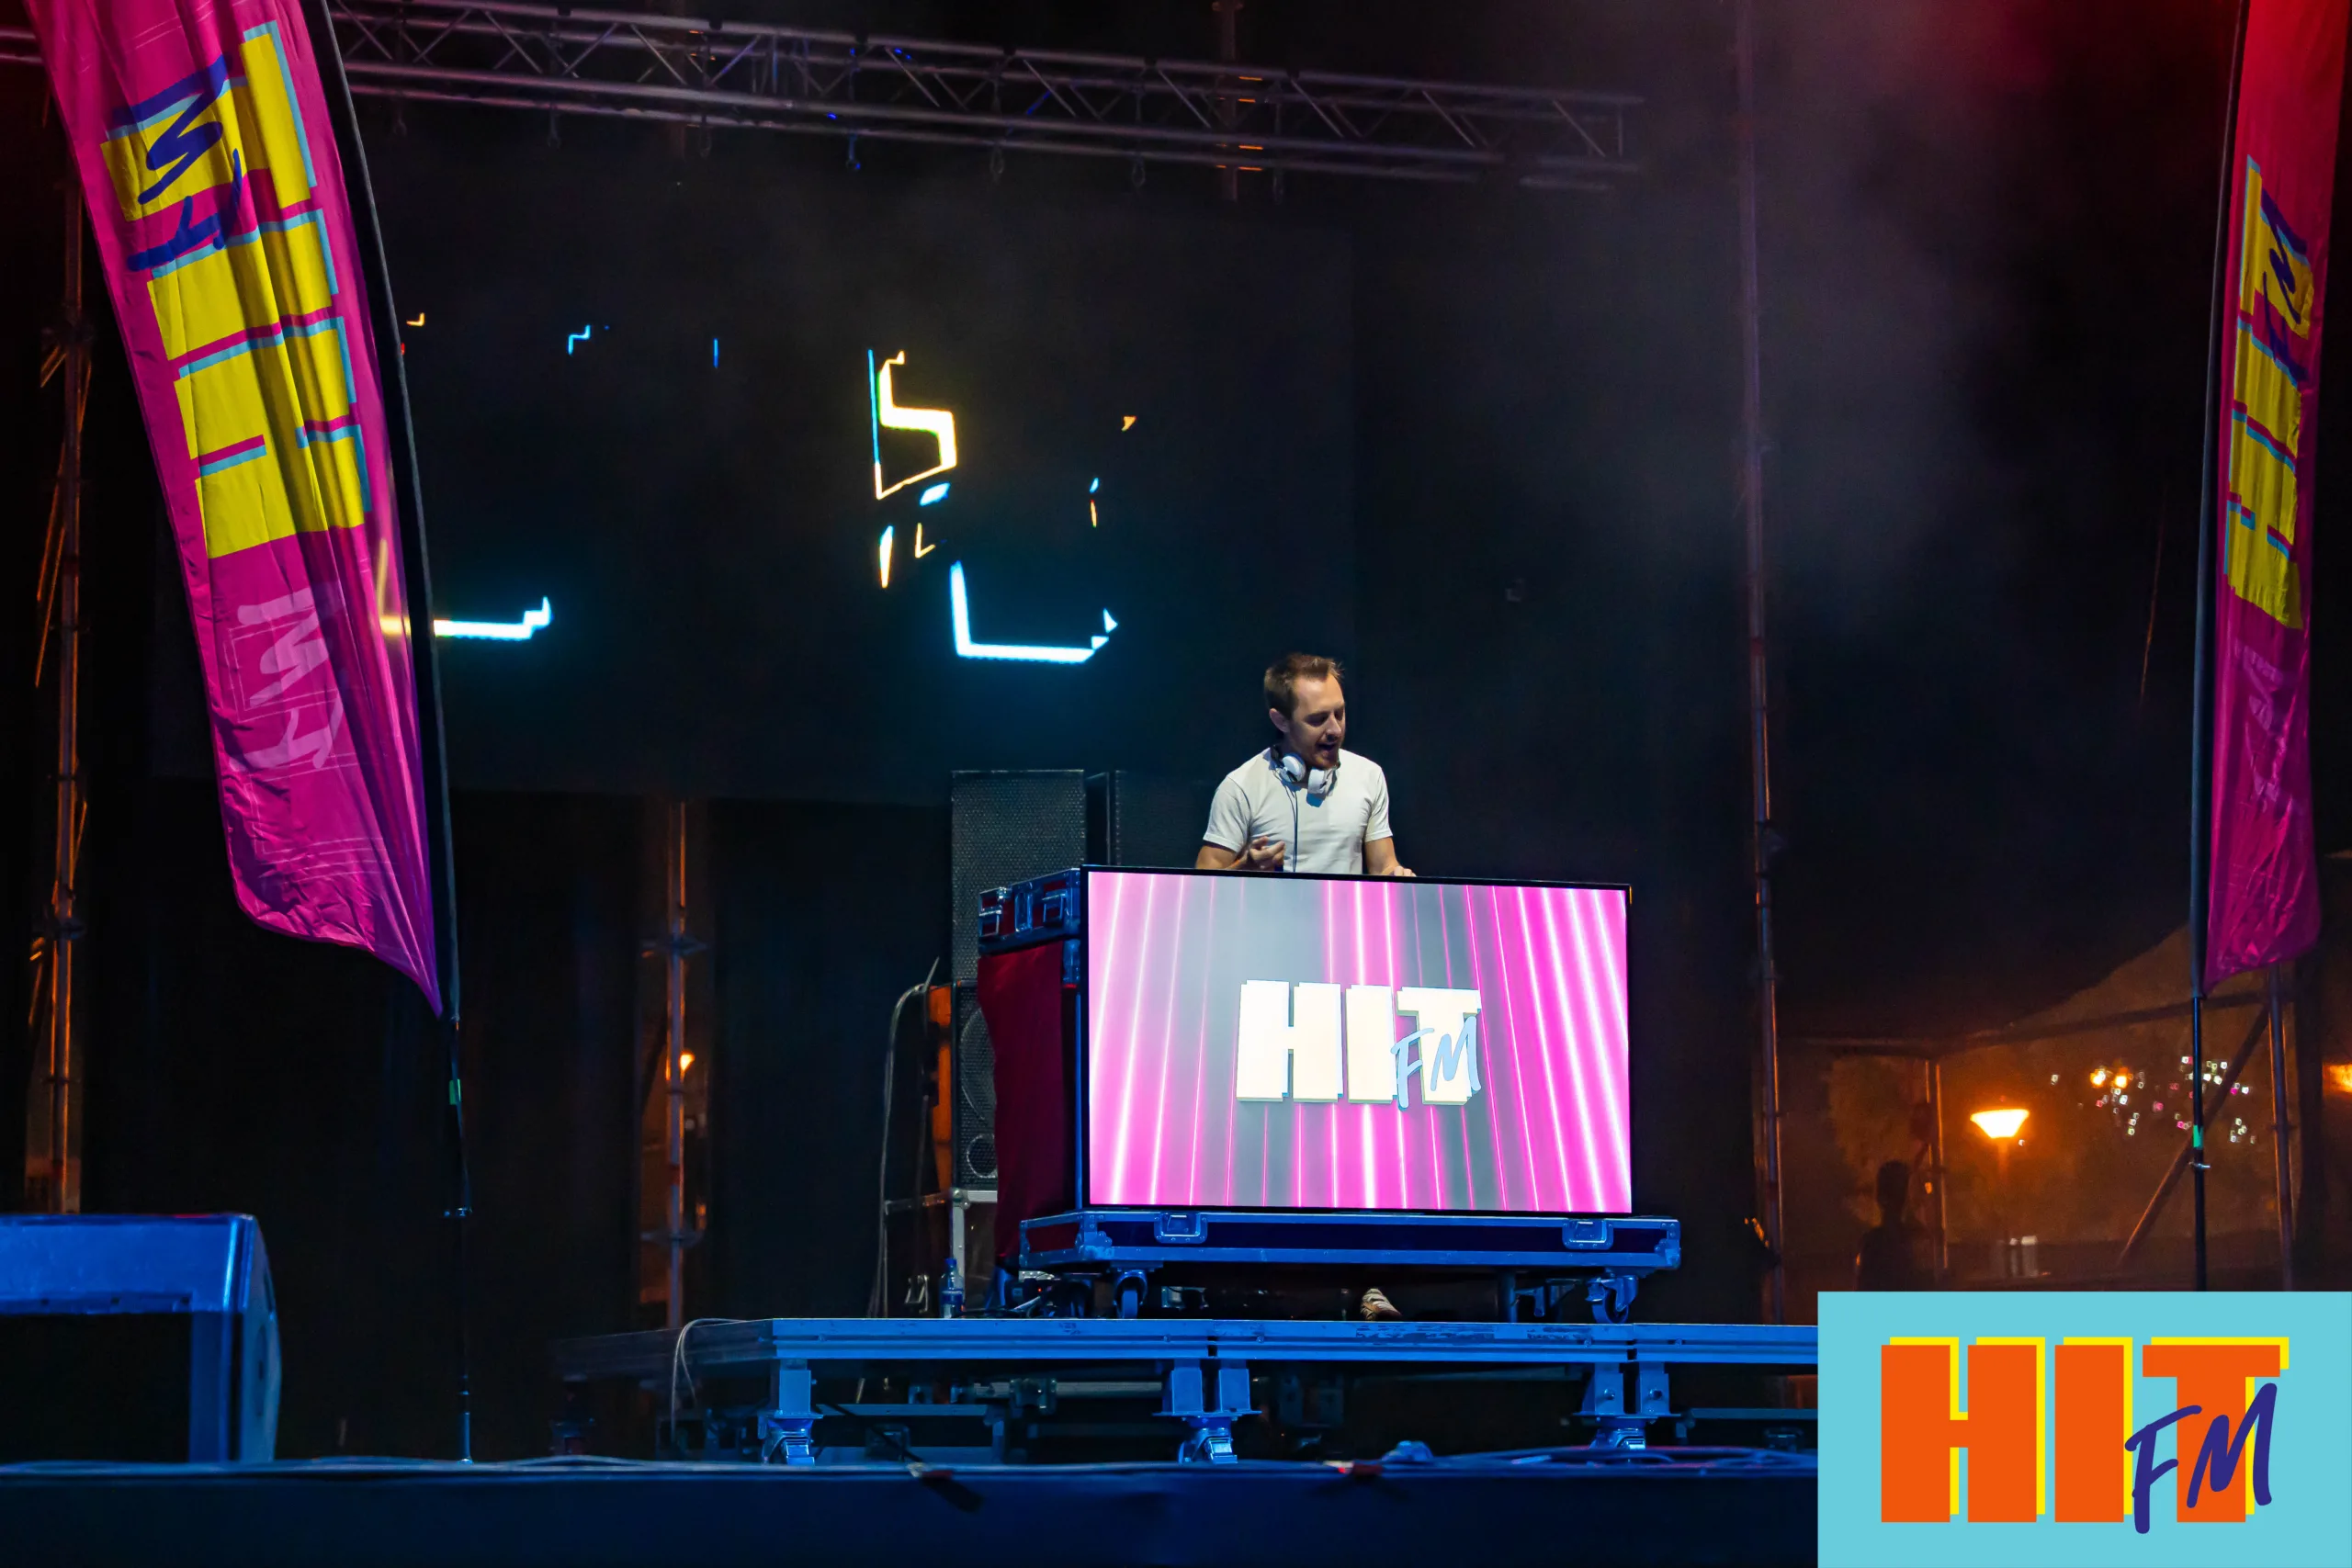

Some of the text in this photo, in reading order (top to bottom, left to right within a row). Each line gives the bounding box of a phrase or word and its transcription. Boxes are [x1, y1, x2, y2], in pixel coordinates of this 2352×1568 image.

[2223, 153, 2313, 629] HIT
[1236, 979, 1482, 1111] HIT FM
